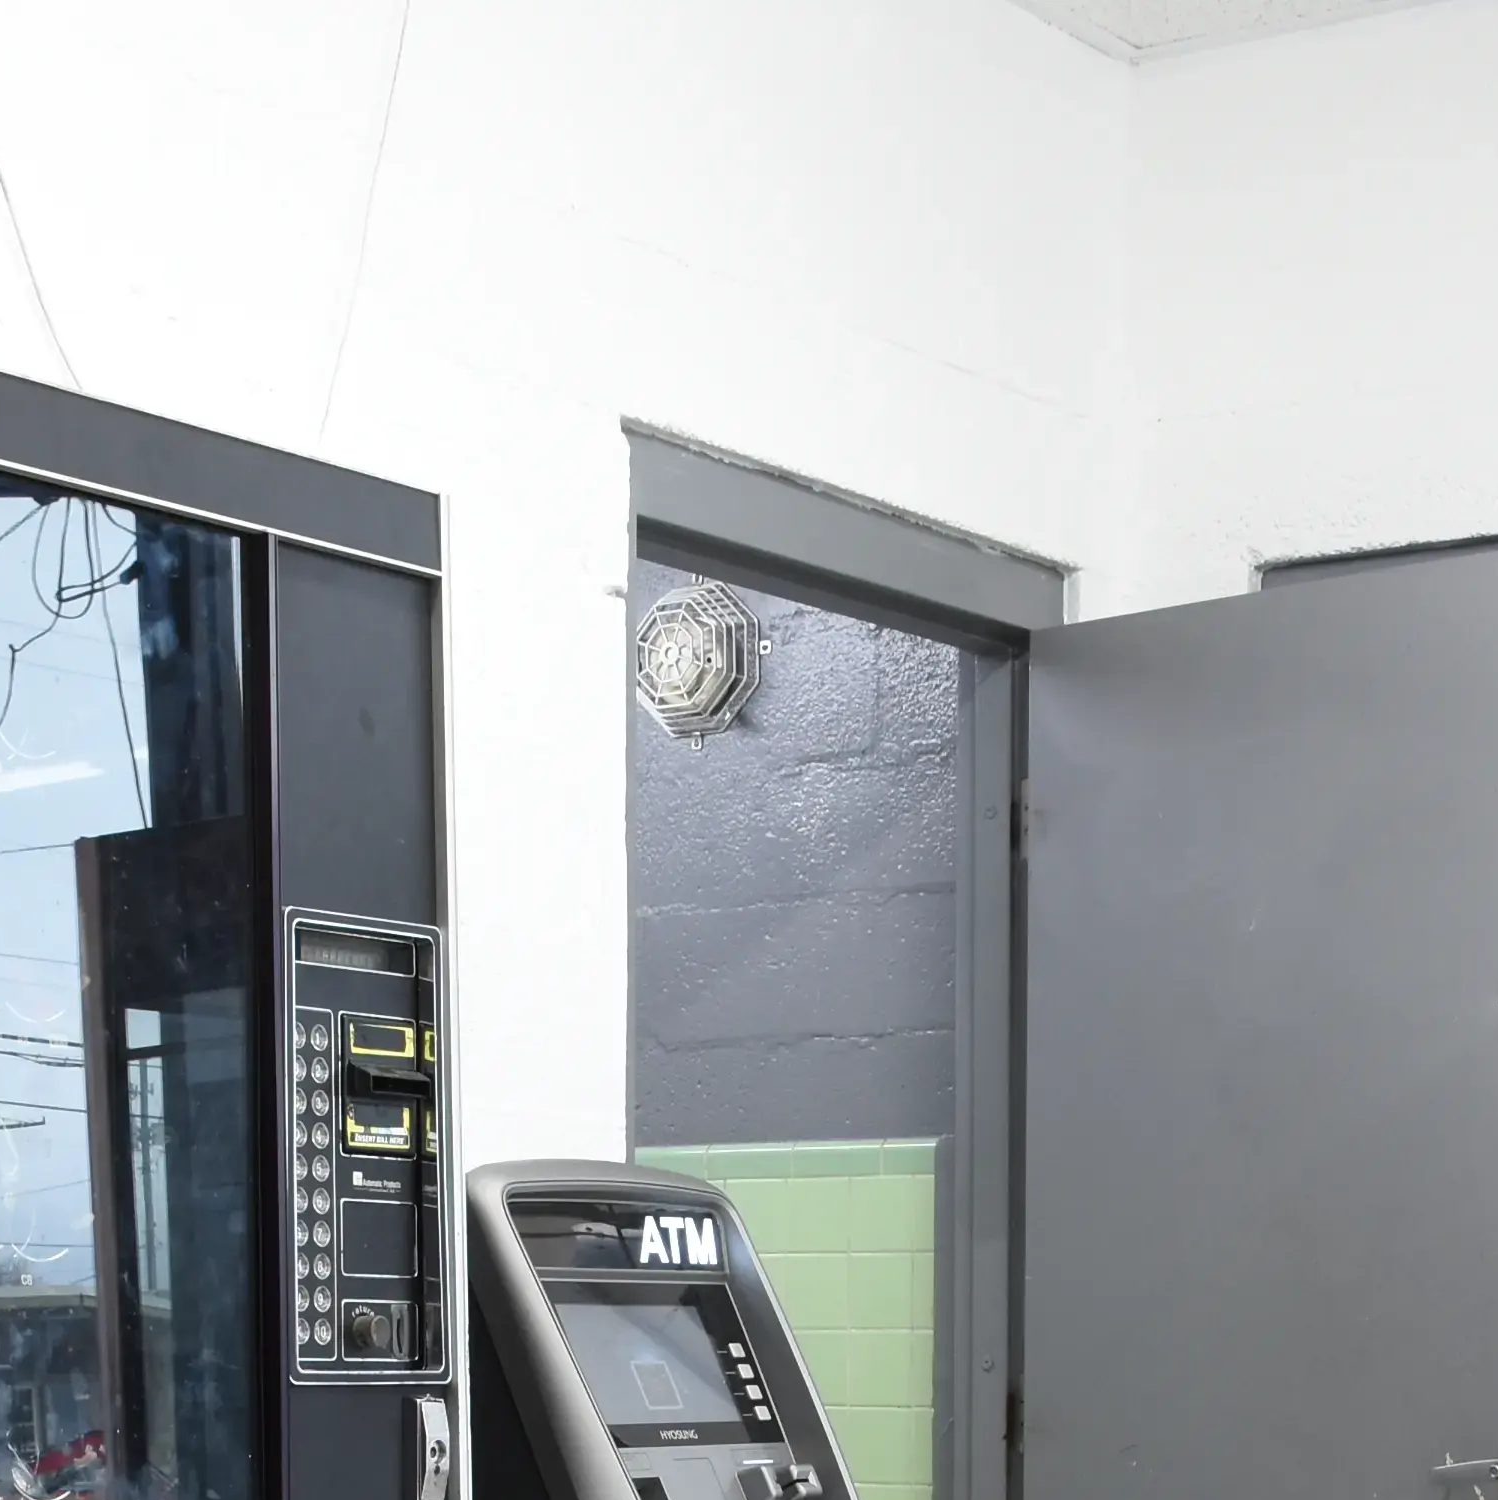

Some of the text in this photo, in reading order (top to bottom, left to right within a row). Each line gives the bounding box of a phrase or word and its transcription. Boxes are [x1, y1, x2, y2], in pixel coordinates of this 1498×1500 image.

[355, 1134, 405, 1145] INSERT BILL HERE
[639, 1215, 718, 1265] ATM
[351, 1305, 375, 1317] return
[659, 1430, 698, 1440] HYOSUNG
